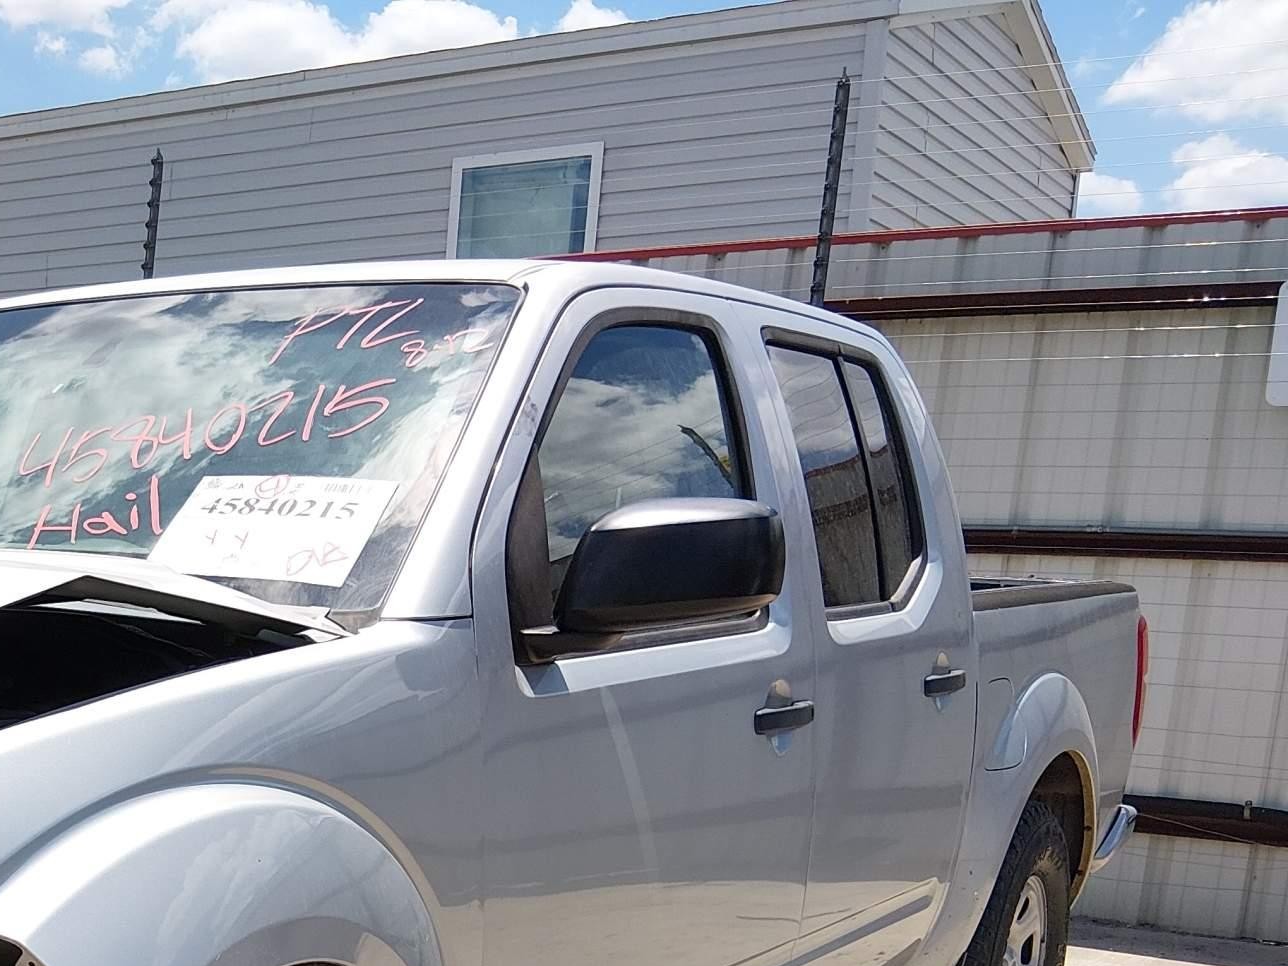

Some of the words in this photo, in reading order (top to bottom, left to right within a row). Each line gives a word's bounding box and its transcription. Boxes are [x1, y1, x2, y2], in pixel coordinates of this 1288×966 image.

[16, 377, 399, 489] 45840215
[27, 475, 165, 550] Hail
[199, 495, 361, 520] 45840215
